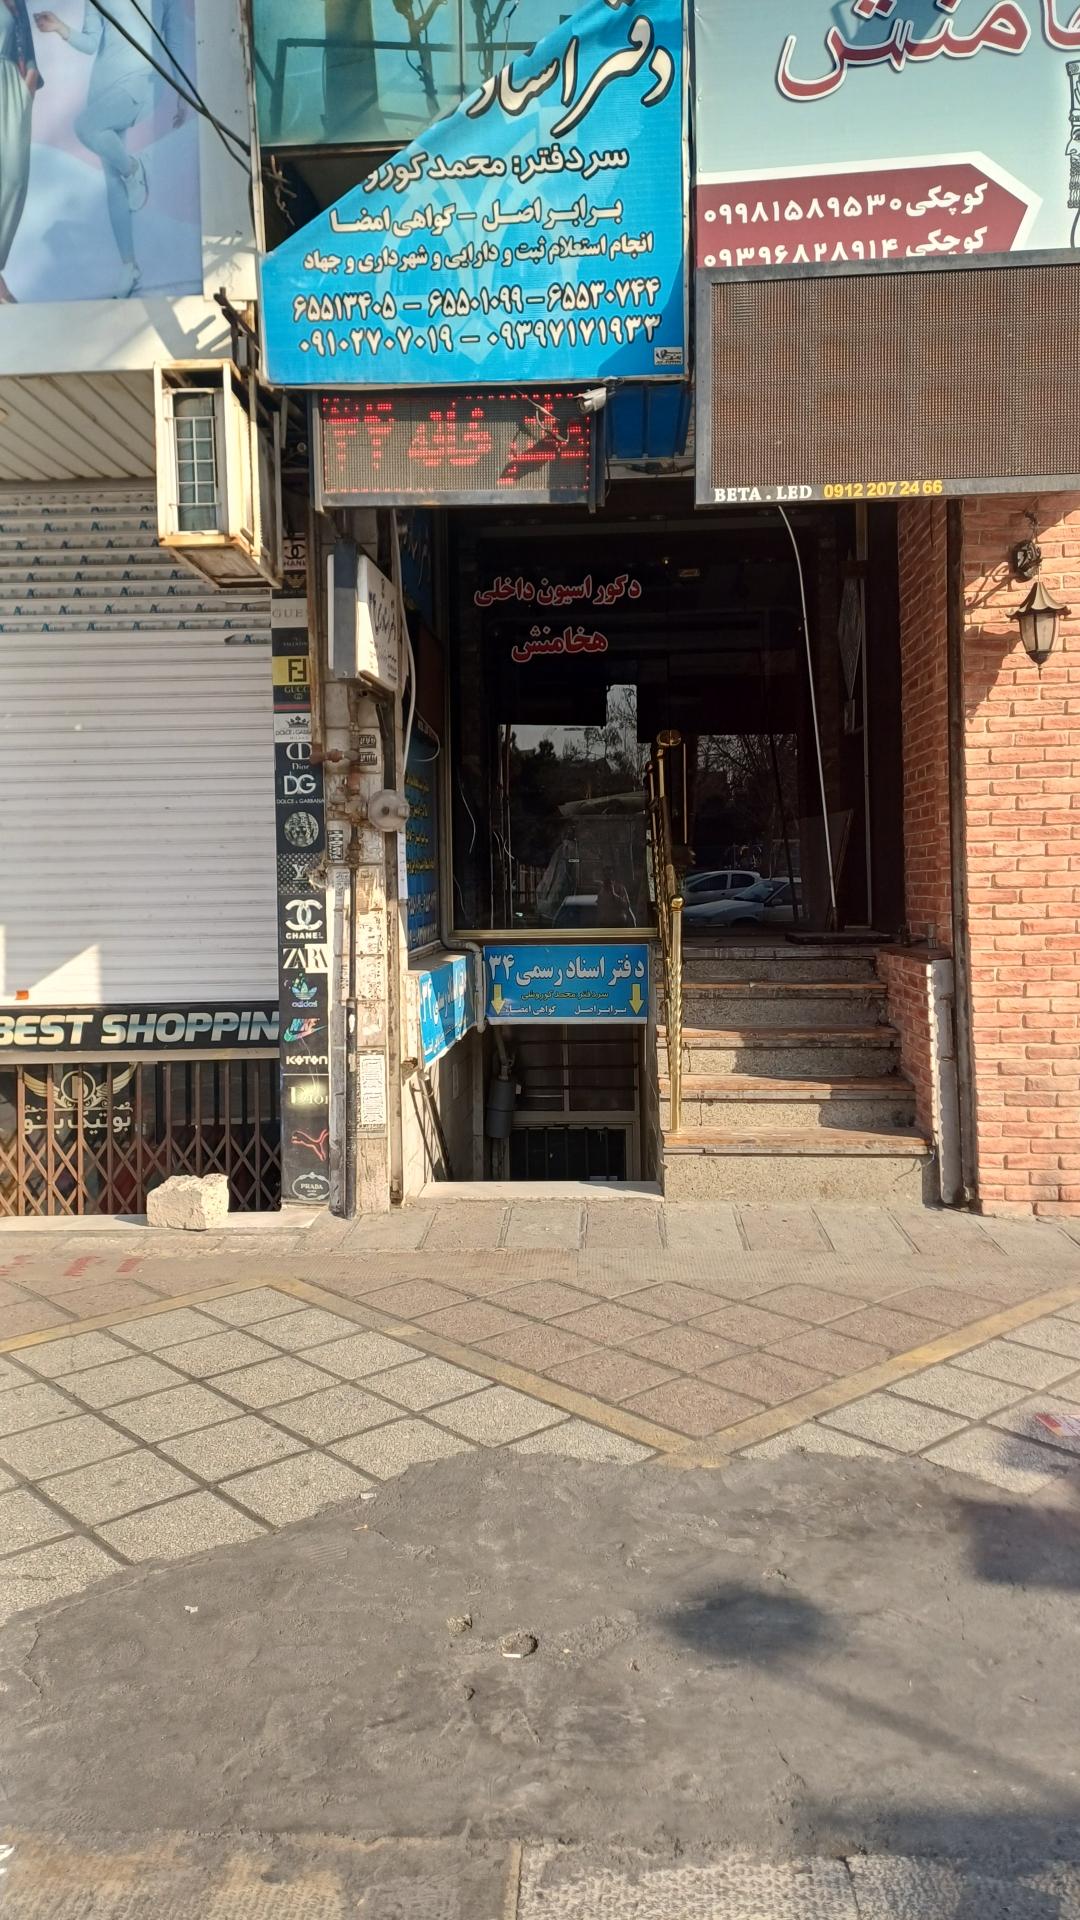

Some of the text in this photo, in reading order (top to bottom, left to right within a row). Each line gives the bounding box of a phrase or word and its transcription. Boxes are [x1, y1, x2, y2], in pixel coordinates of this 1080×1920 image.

[427, 155, 507, 180] محمد
[512, 143, 629, 183] سردفتر:
[329, 204, 391, 232] امضا
[481, 195, 542, 232] اصل
[543, 194, 624, 230] برابر
[703, 182, 988, 225] کوچکی ۰۹۹۸۱۵۸۹۵۳۰
[391, 202, 456, 237] گواهی
[303, 248, 343, 275] جهاد
[431, 250, 443, 270] و
[443, 240, 499, 270] دارایی
[501, 247, 513, 267] و
[515, 235, 546, 264] ثبت
[547, 233, 607, 264] استعلام
[607, 231, 653, 261] انجام
[344, 255, 356, 275] و
[293, 291, 397, 323] ۶۵۵۱۳۴۰۵
[428, 284, 524, 318] ۶۵۵۰۱۰۹۹
[546, 276, 661, 313] ۶۵۵۳۰۷۴۴
[299, 324, 454, 357] ۰۹۱۰۲۷۰۷۰۱۹
[487, 314, 662, 350] ۰۹۳۹۷۱۷۱۹۳۳
[714, 487, 762, 502] BETA
[777, 485, 812, 499] LED
[824, 483, 863, 498] 0912
[867, 482, 897, 496] 207
[901, 480, 920, 494] 24
[923, 480, 943, 494] 66
[474, 577, 536, 607] داخلی
[511, 625, 609, 663] هخامنش
[285, 931, 324, 940] CHANEL
[488, 953, 645, 986] دفتر اسناد رسمی ۳۴
[0, 1014, 93, 1046] BEST
